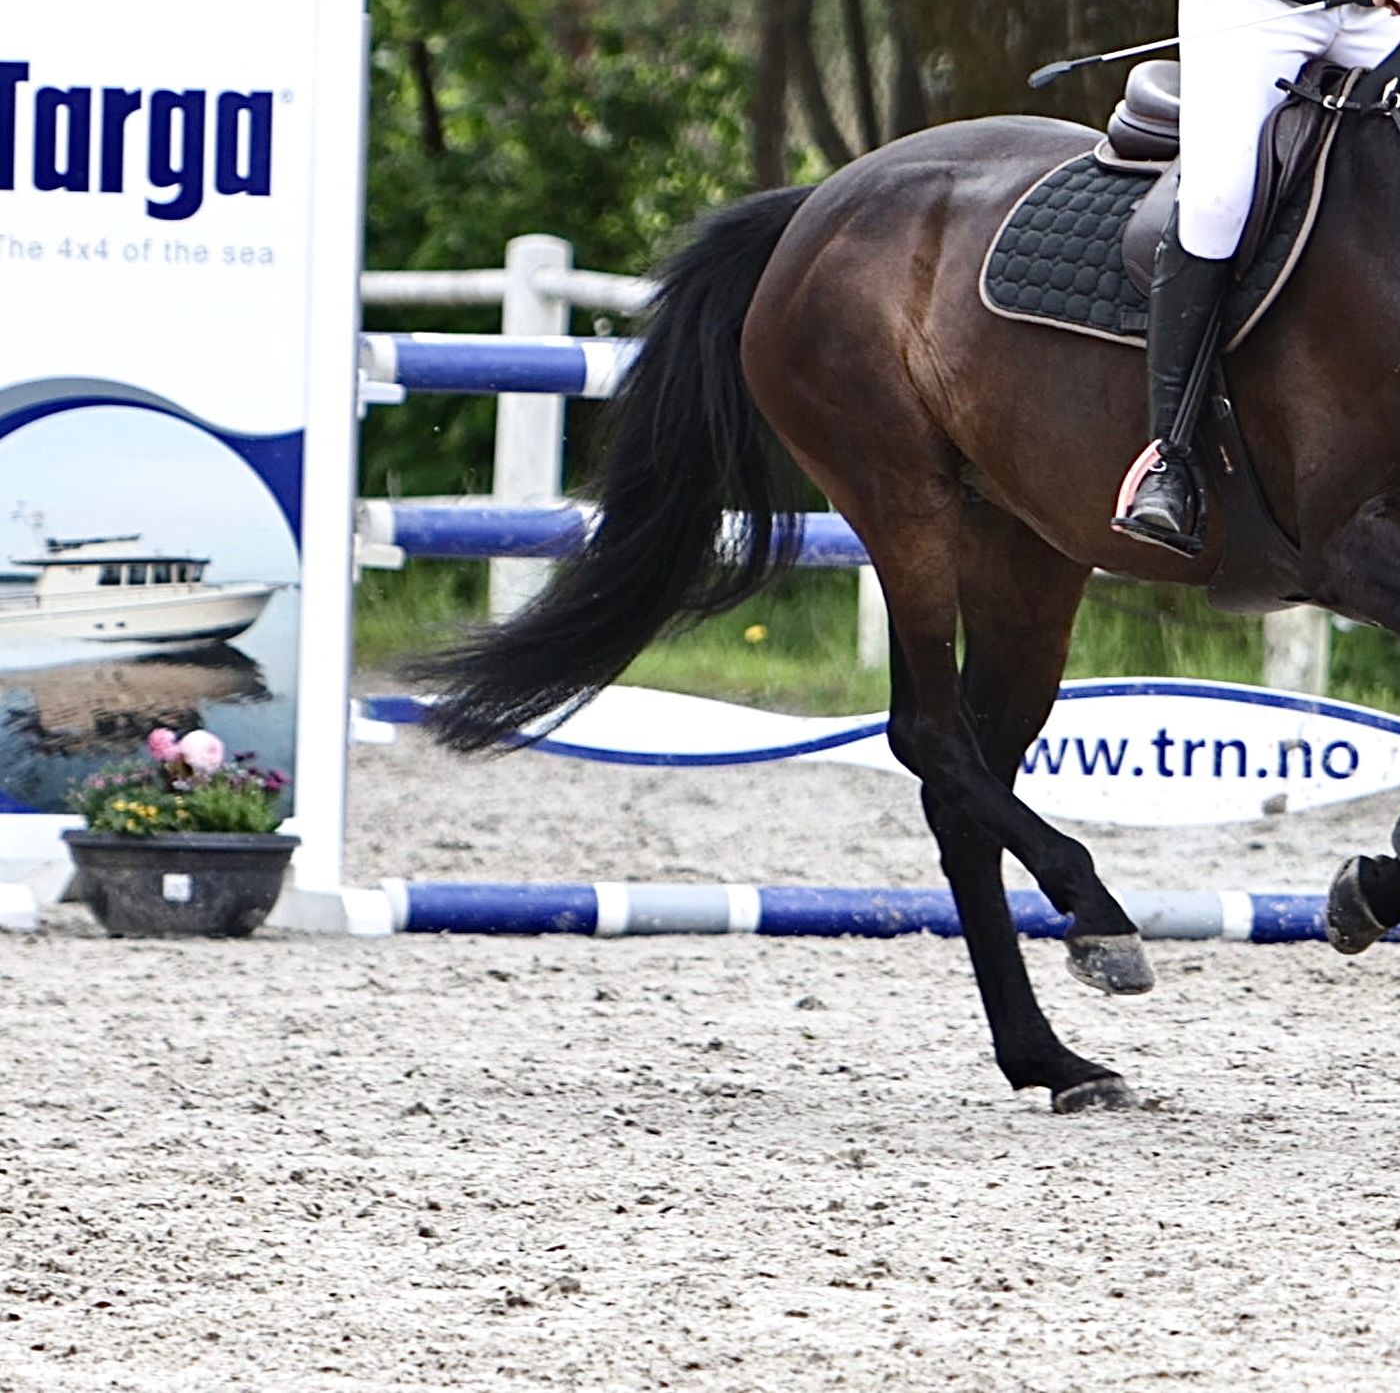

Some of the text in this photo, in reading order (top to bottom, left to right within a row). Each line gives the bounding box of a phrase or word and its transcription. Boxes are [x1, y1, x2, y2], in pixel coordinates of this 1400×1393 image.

[56, 237, 109, 261] 4x4
[122, 237, 153, 263] of
[163, 239, 209, 264] the
[223, 245, 275, 265] sea
[1022, 727, 1359, 779] ww.trn.no
